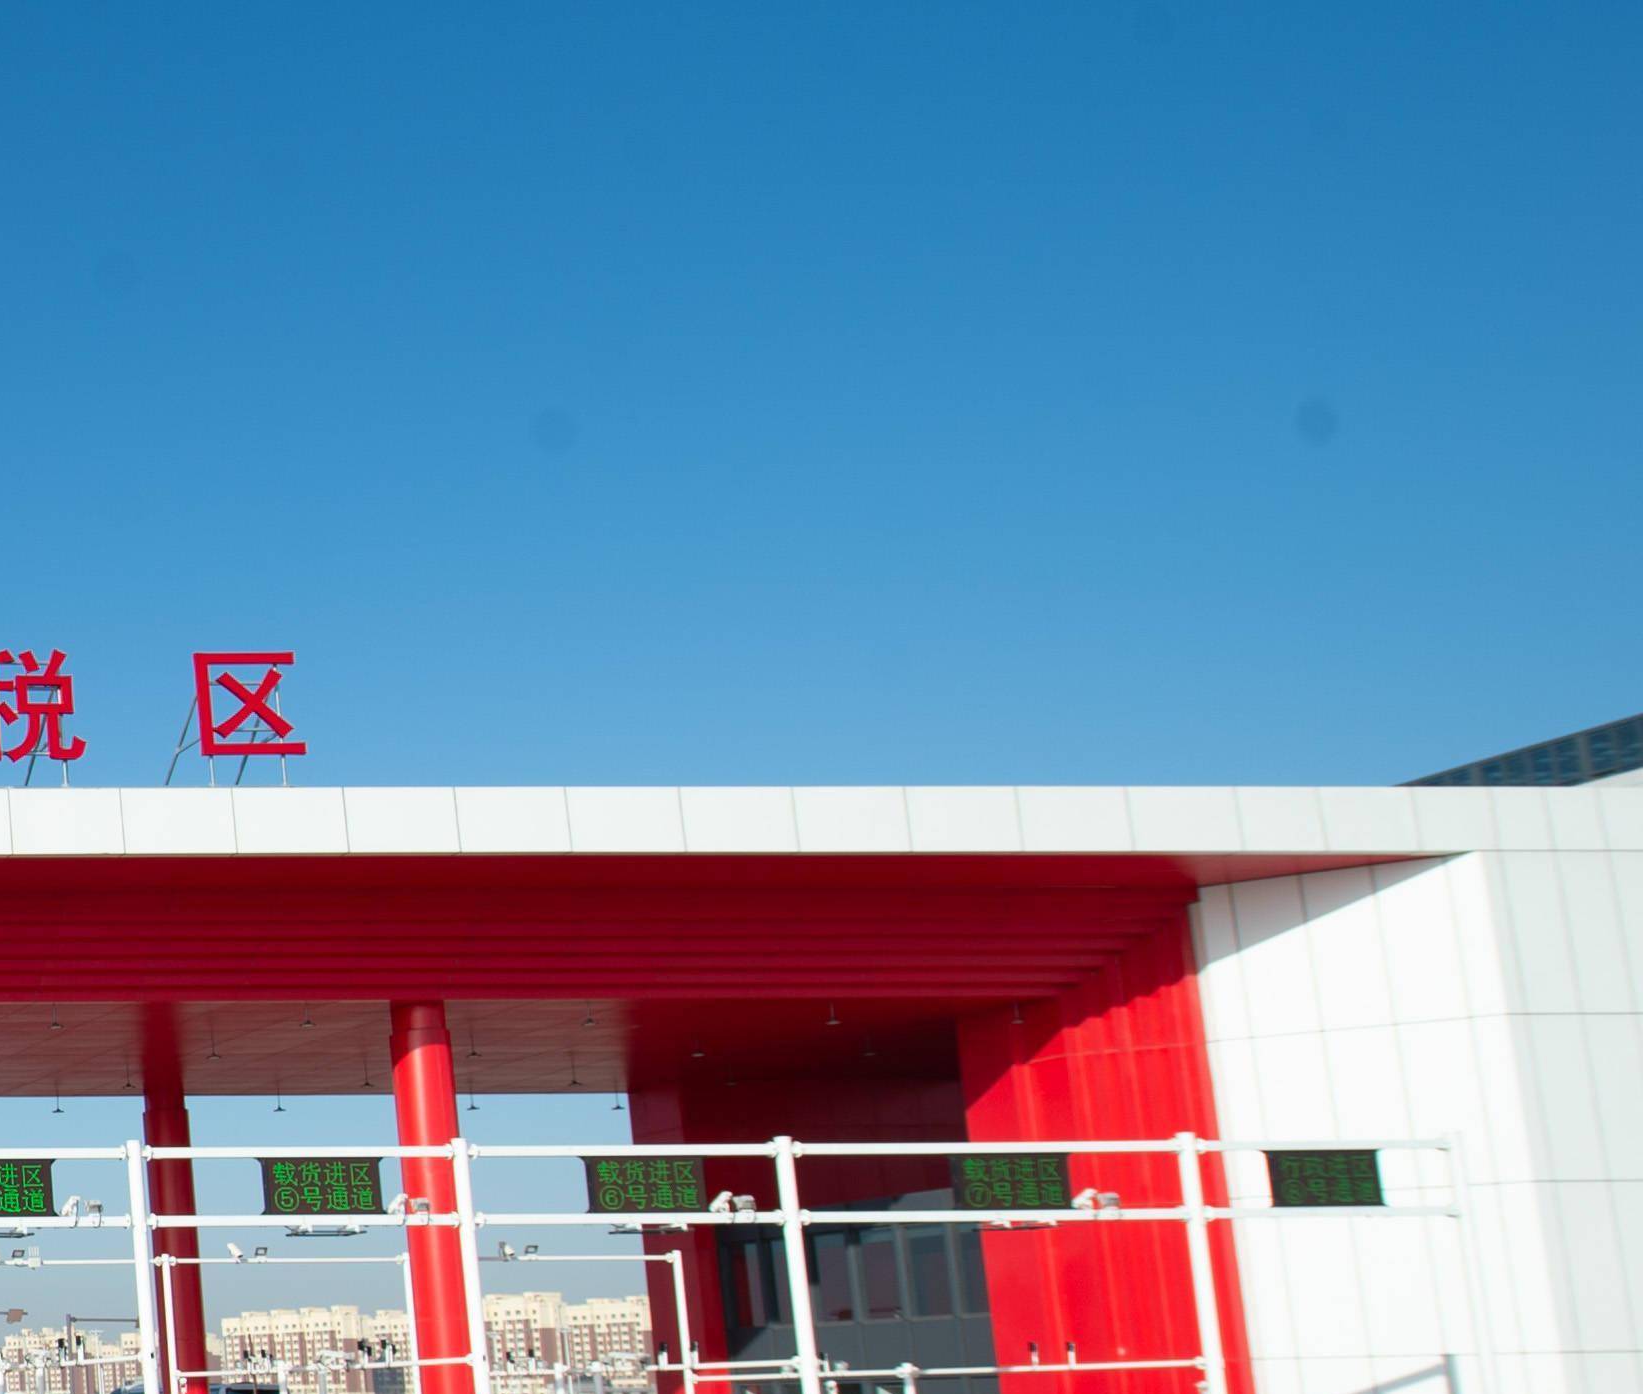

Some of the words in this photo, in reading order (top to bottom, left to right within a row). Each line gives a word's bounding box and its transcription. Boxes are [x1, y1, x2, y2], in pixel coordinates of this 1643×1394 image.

[273, 1162, 371, 1185] 载货进区
[597, 1161, 698, 1185] 载货进区
